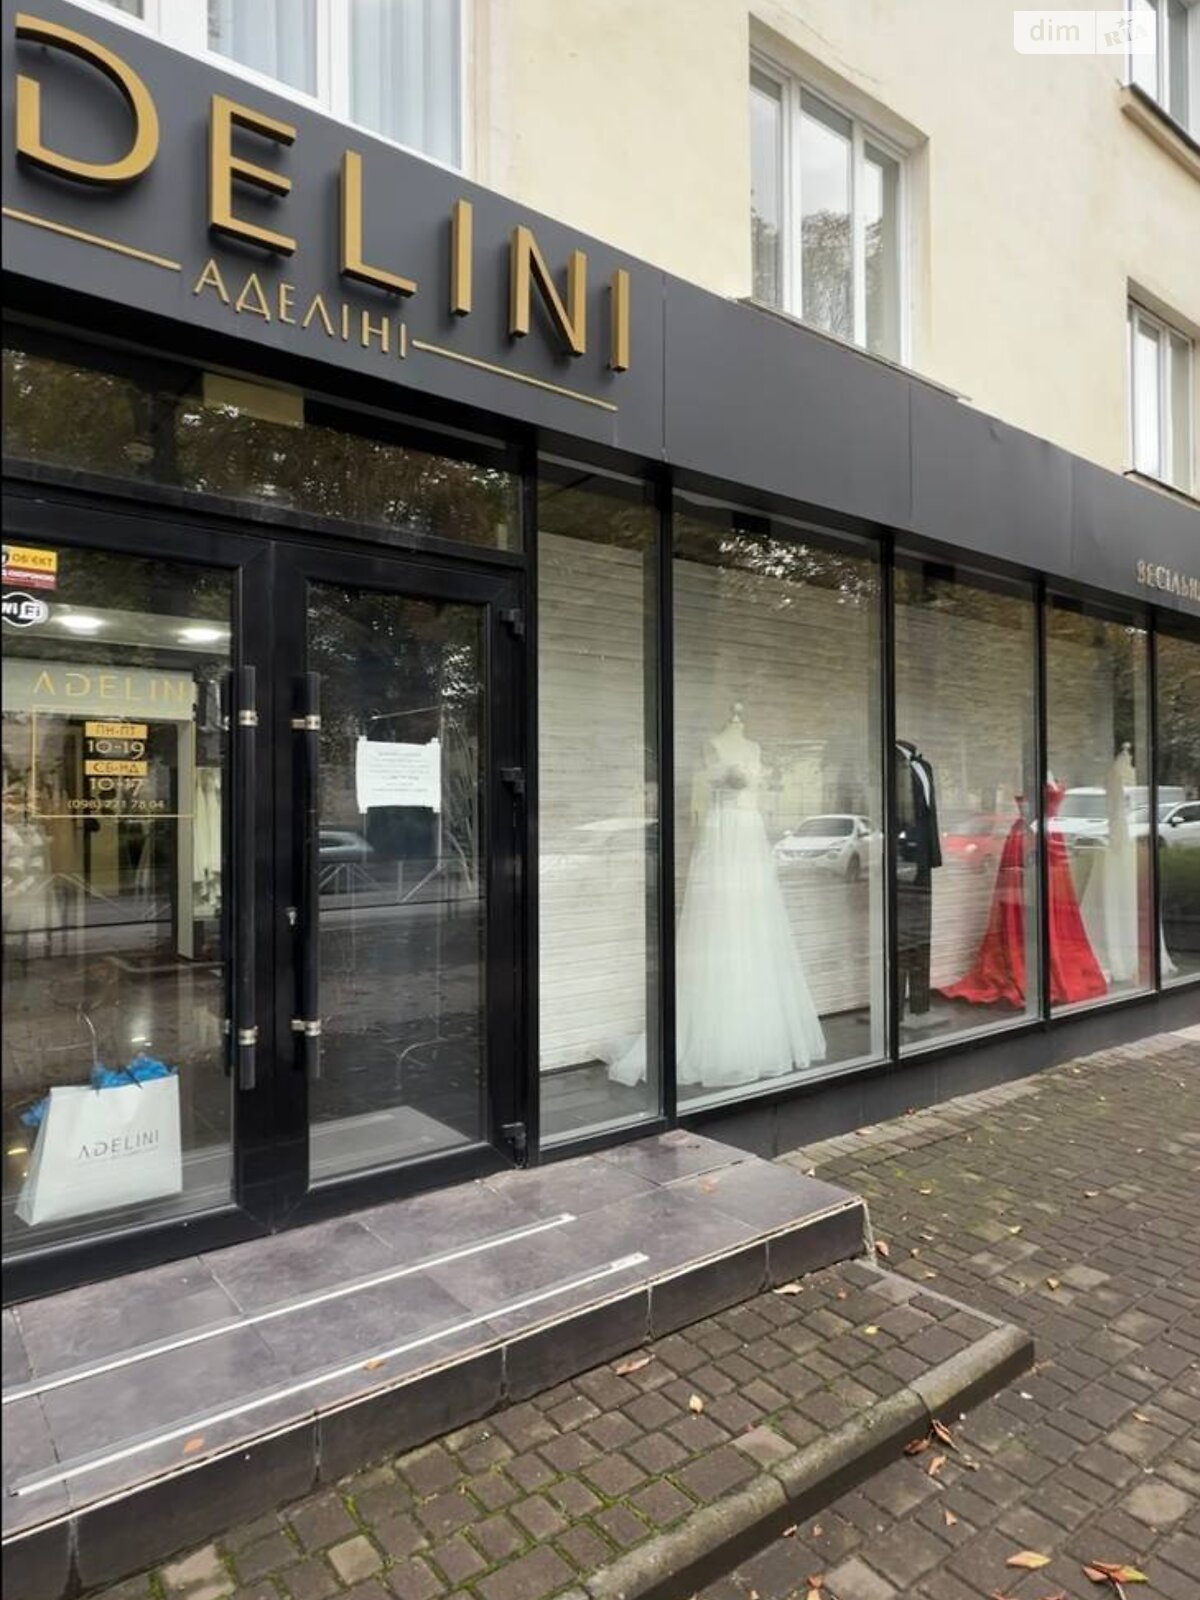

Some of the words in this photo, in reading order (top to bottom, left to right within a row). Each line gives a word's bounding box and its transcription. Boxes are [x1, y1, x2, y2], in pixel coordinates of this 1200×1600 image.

[193, 258, 409, 359] АДЕЛІНІ
[88, 741, 145, 760] 10-19
[78, 1129, 159, 1160] ADELINI
